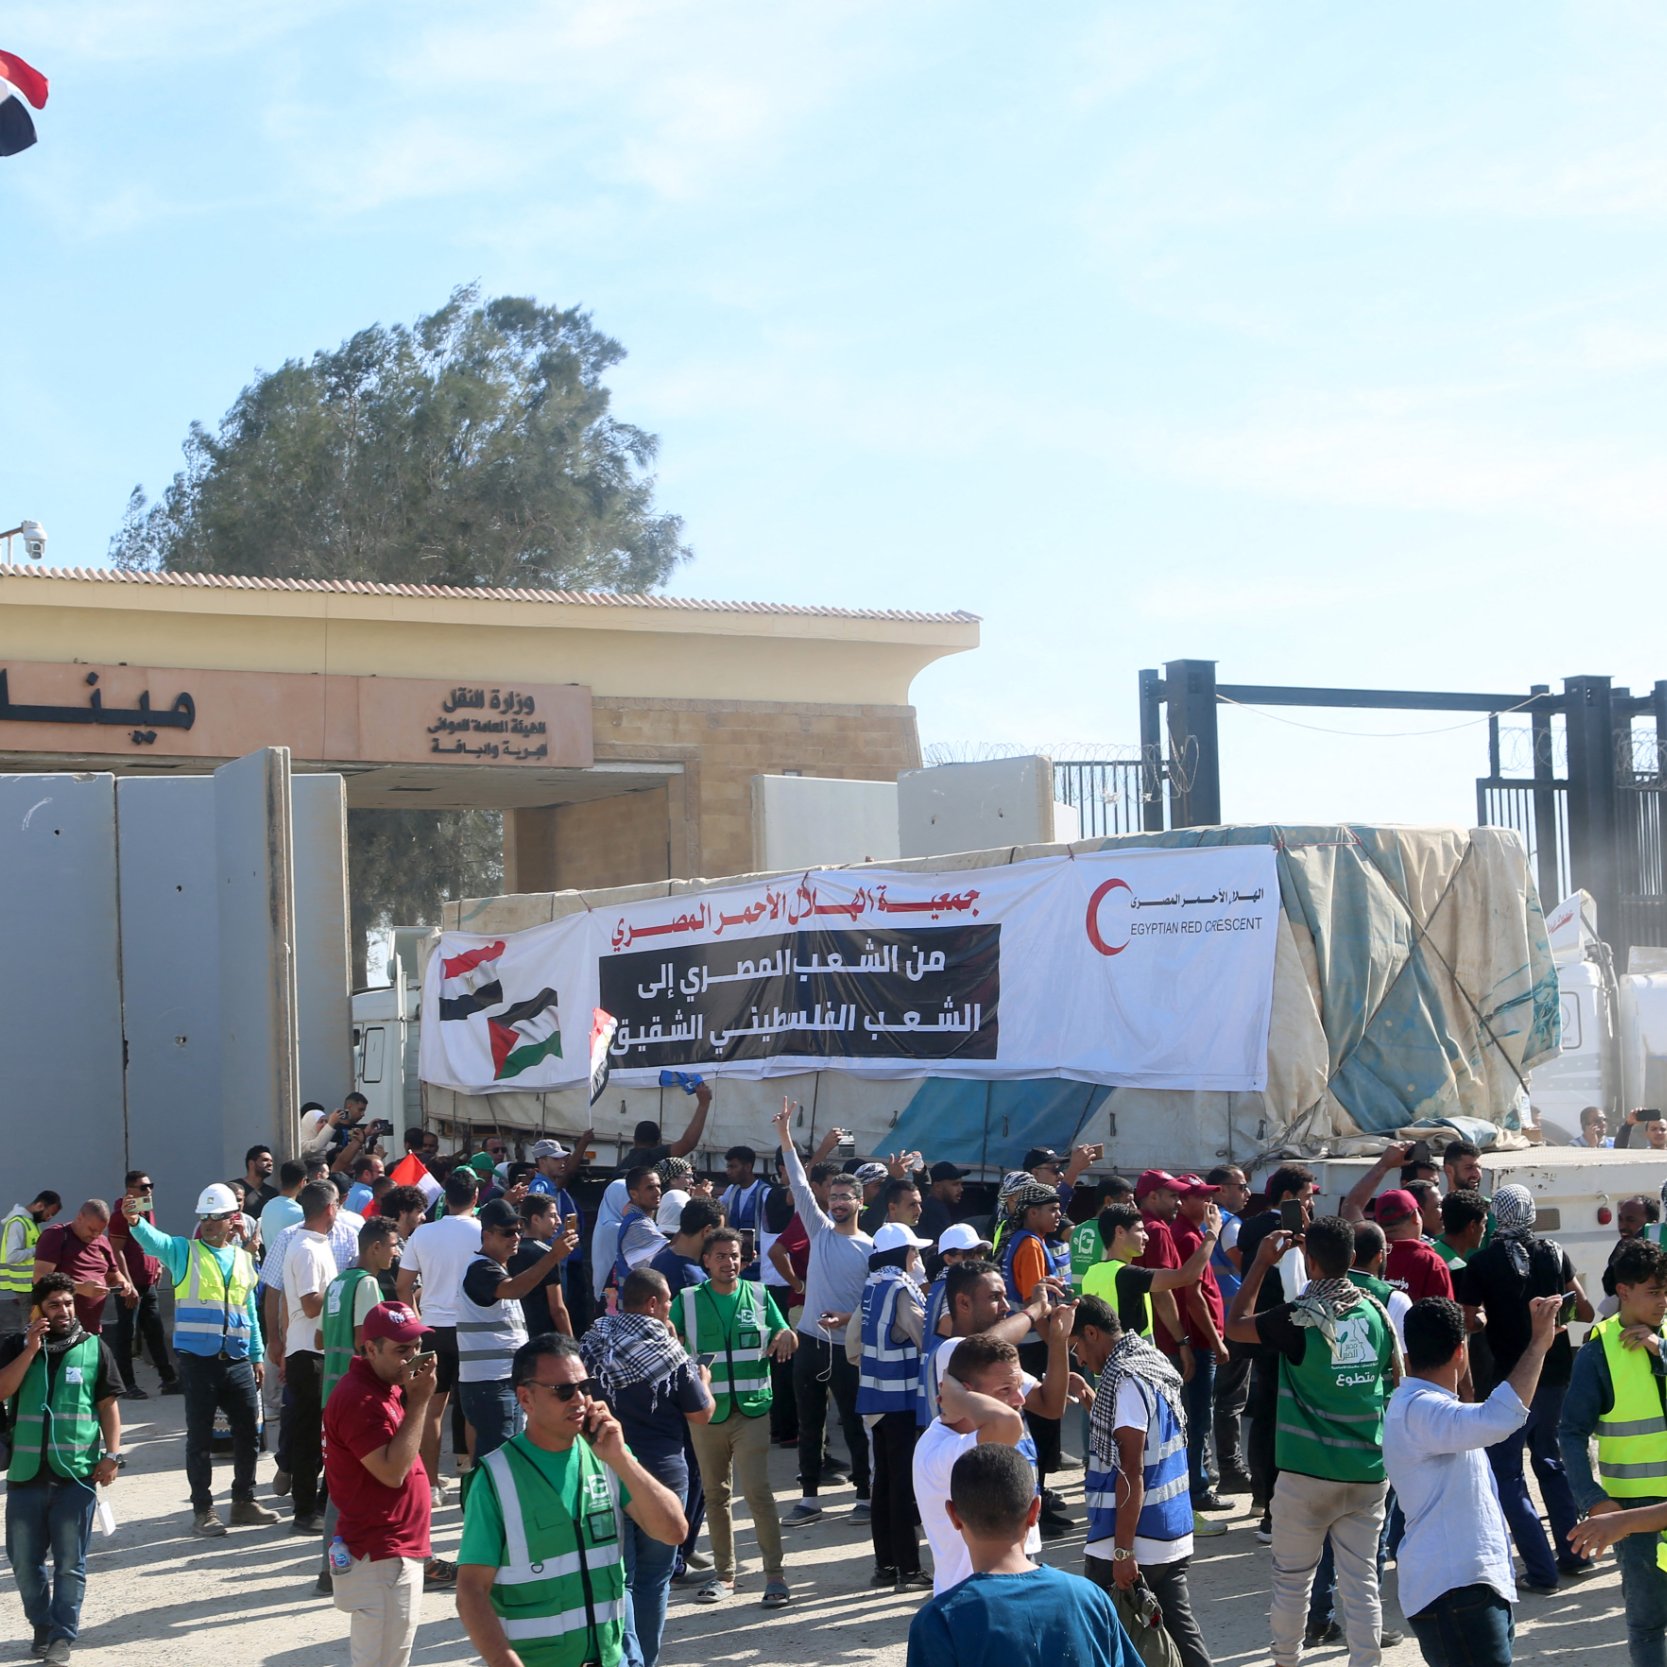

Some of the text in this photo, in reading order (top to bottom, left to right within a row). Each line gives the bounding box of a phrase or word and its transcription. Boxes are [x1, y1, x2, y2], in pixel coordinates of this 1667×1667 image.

[0, 668, 196, 746] مينا
[443, 686, 536, 716] وزارة النقل
[610, 884, 982, 952] جمعية الهلال الأحمر المصري
[1130, 917, 1263, 936] EGYPTIAN RED CRESCENT
[637, 938, 946, 1002] من الشعب المصري إلى
[609, 995, 982, 1056] الشعب الفلسطيني الشقيق
[1335, 1371, 1375, 1387] متطوع
